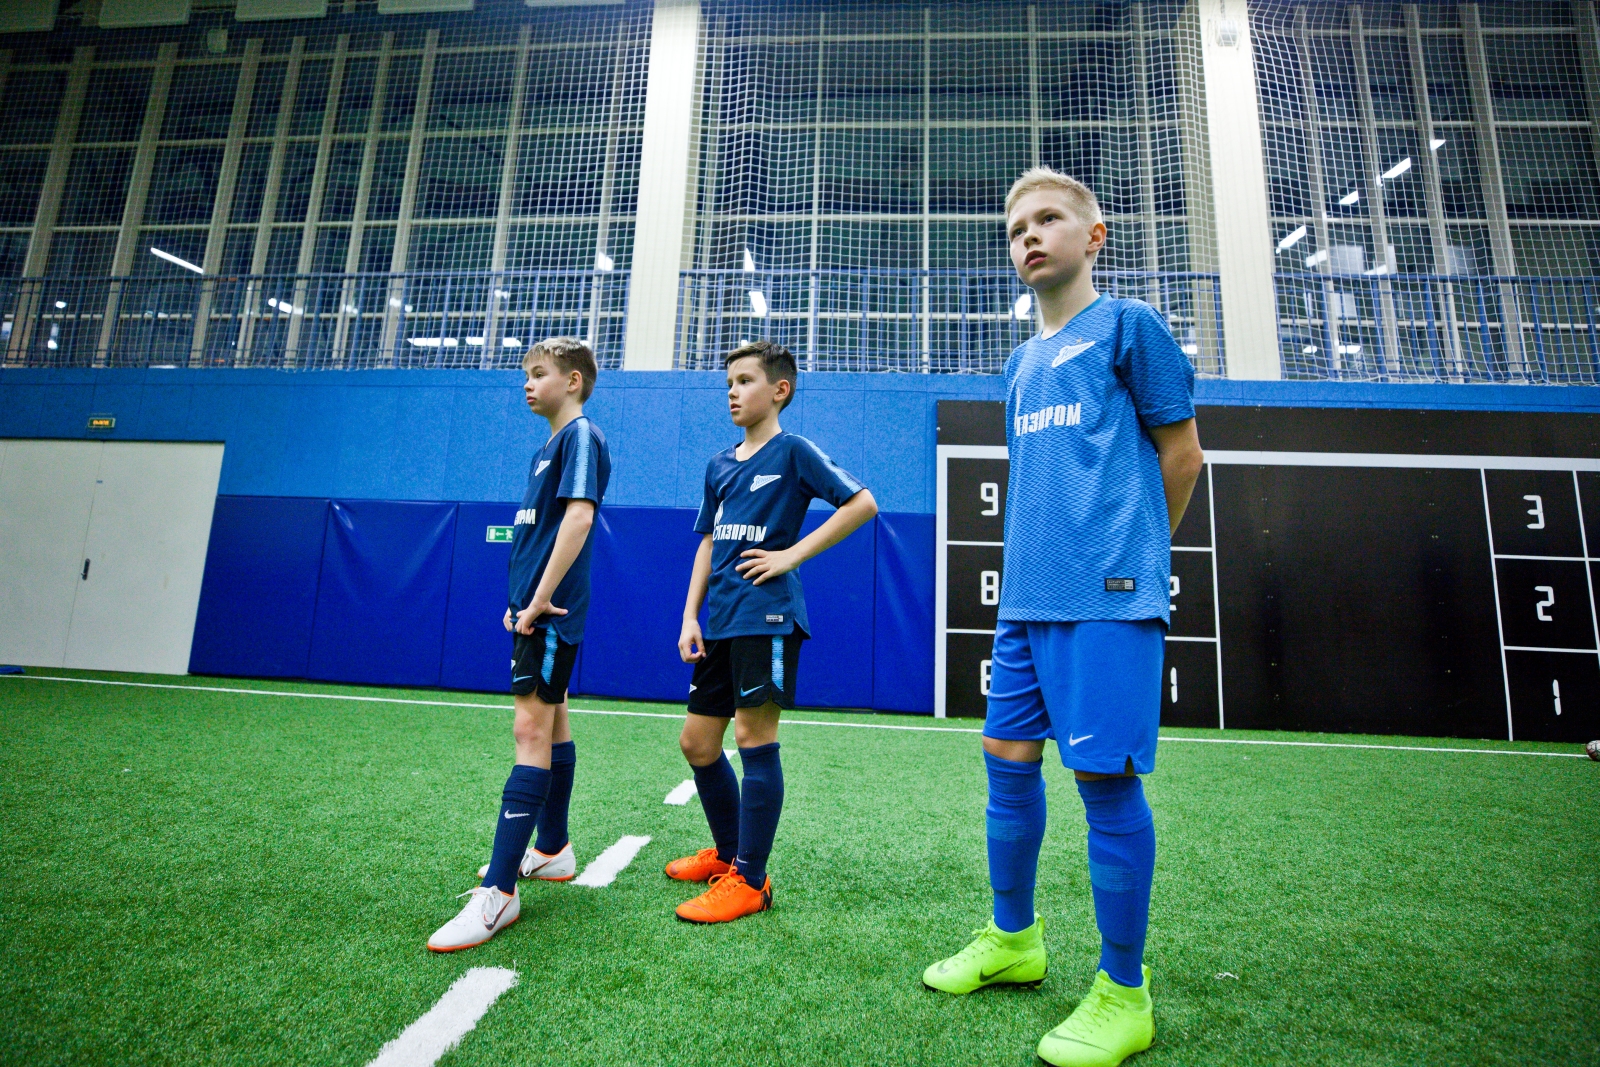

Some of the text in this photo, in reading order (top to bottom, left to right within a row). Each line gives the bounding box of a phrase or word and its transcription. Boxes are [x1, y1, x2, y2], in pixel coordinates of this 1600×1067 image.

[1015, 402, 1081, 437] ГАЗПРОМ
[981, 482, 999, 516] 9
[1523, 494, 1545, 529] 3
[716, 523, 767, 542] ГАЗПРОМ
[981, 570, 1000, 606] 8
[1534, 585, 1555, 622] 2
[1170, 666, 1178, 704] 1
[1552, 679, 1562, 716] 1
